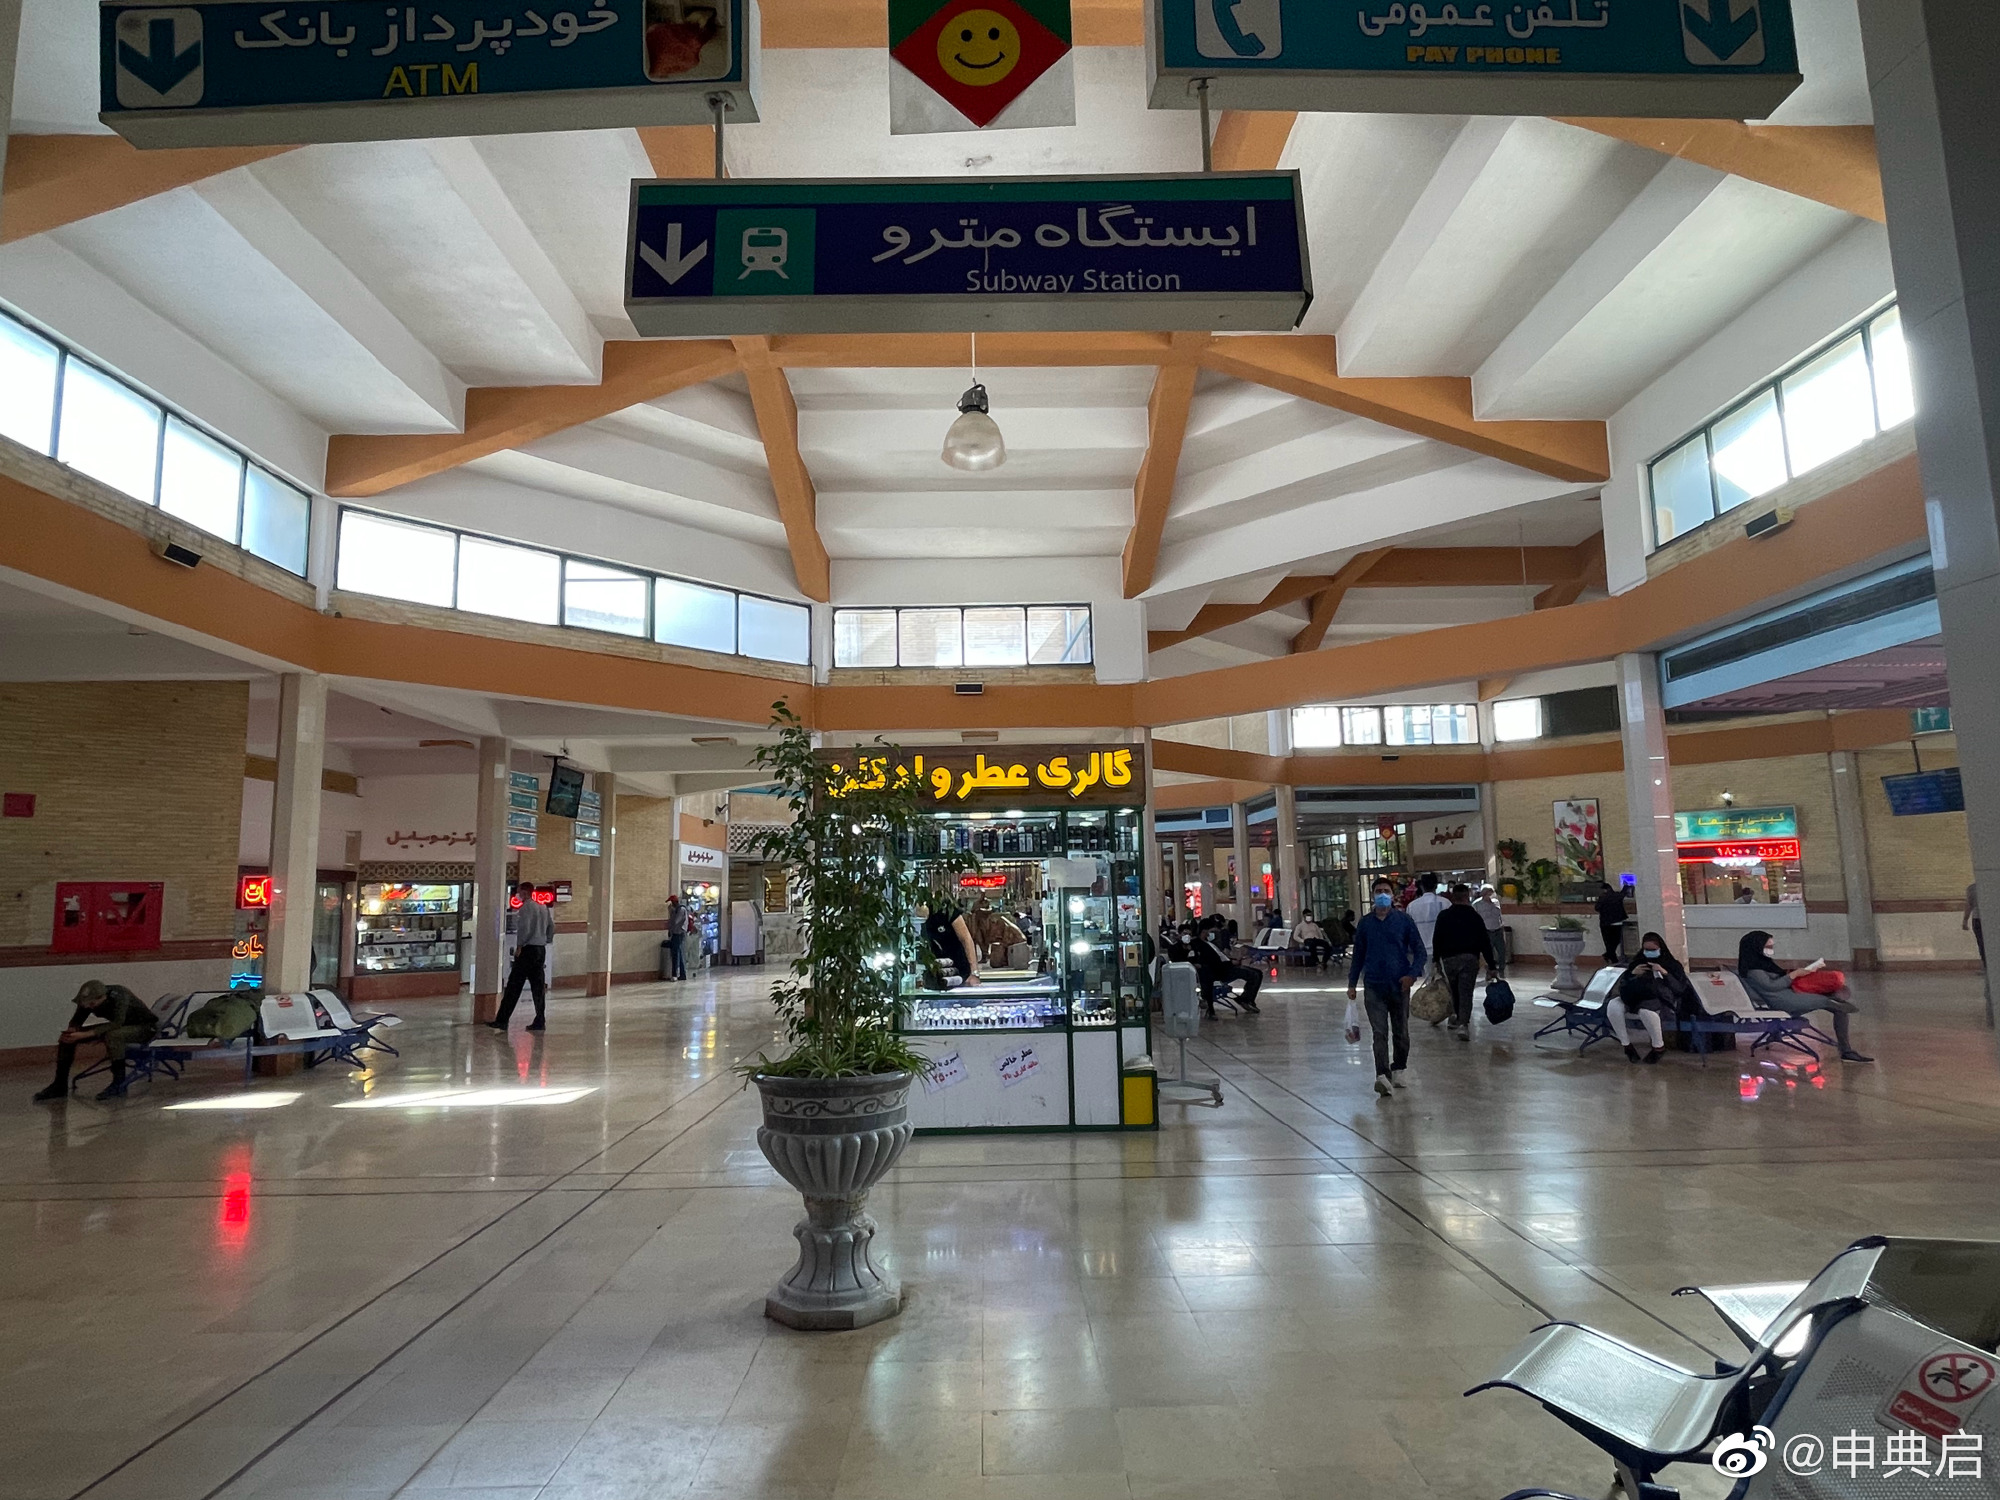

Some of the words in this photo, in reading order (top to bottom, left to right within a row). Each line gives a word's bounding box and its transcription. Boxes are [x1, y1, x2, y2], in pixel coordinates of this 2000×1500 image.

[234, 9, 356, 58] بانک
[371, 0, 619, 55] خودپرداز
[1358, 2, 1495, 38] عمومی
[1504, 0, 1609, 39] تلفن
[1406, 46, 1459, 63] PAY
[1466, 47, 1562, 64] PHONE
[382, 62, 479, 98] ATM
[871, 218, 1022, 265] مترو
[1034, 204, 1257, 256] ایستگاه
[965, 268, 1075, 293] Subway
[1082, 268, 1181, 291] Station
[930, 766, 952, 800] و
[956, 753, 1030, 799] عطر
[1036, 747, 1133, 798] گالری
[387, 830, 450, 849] موبایل
[1757, 844, 1794, 857] کازرون
